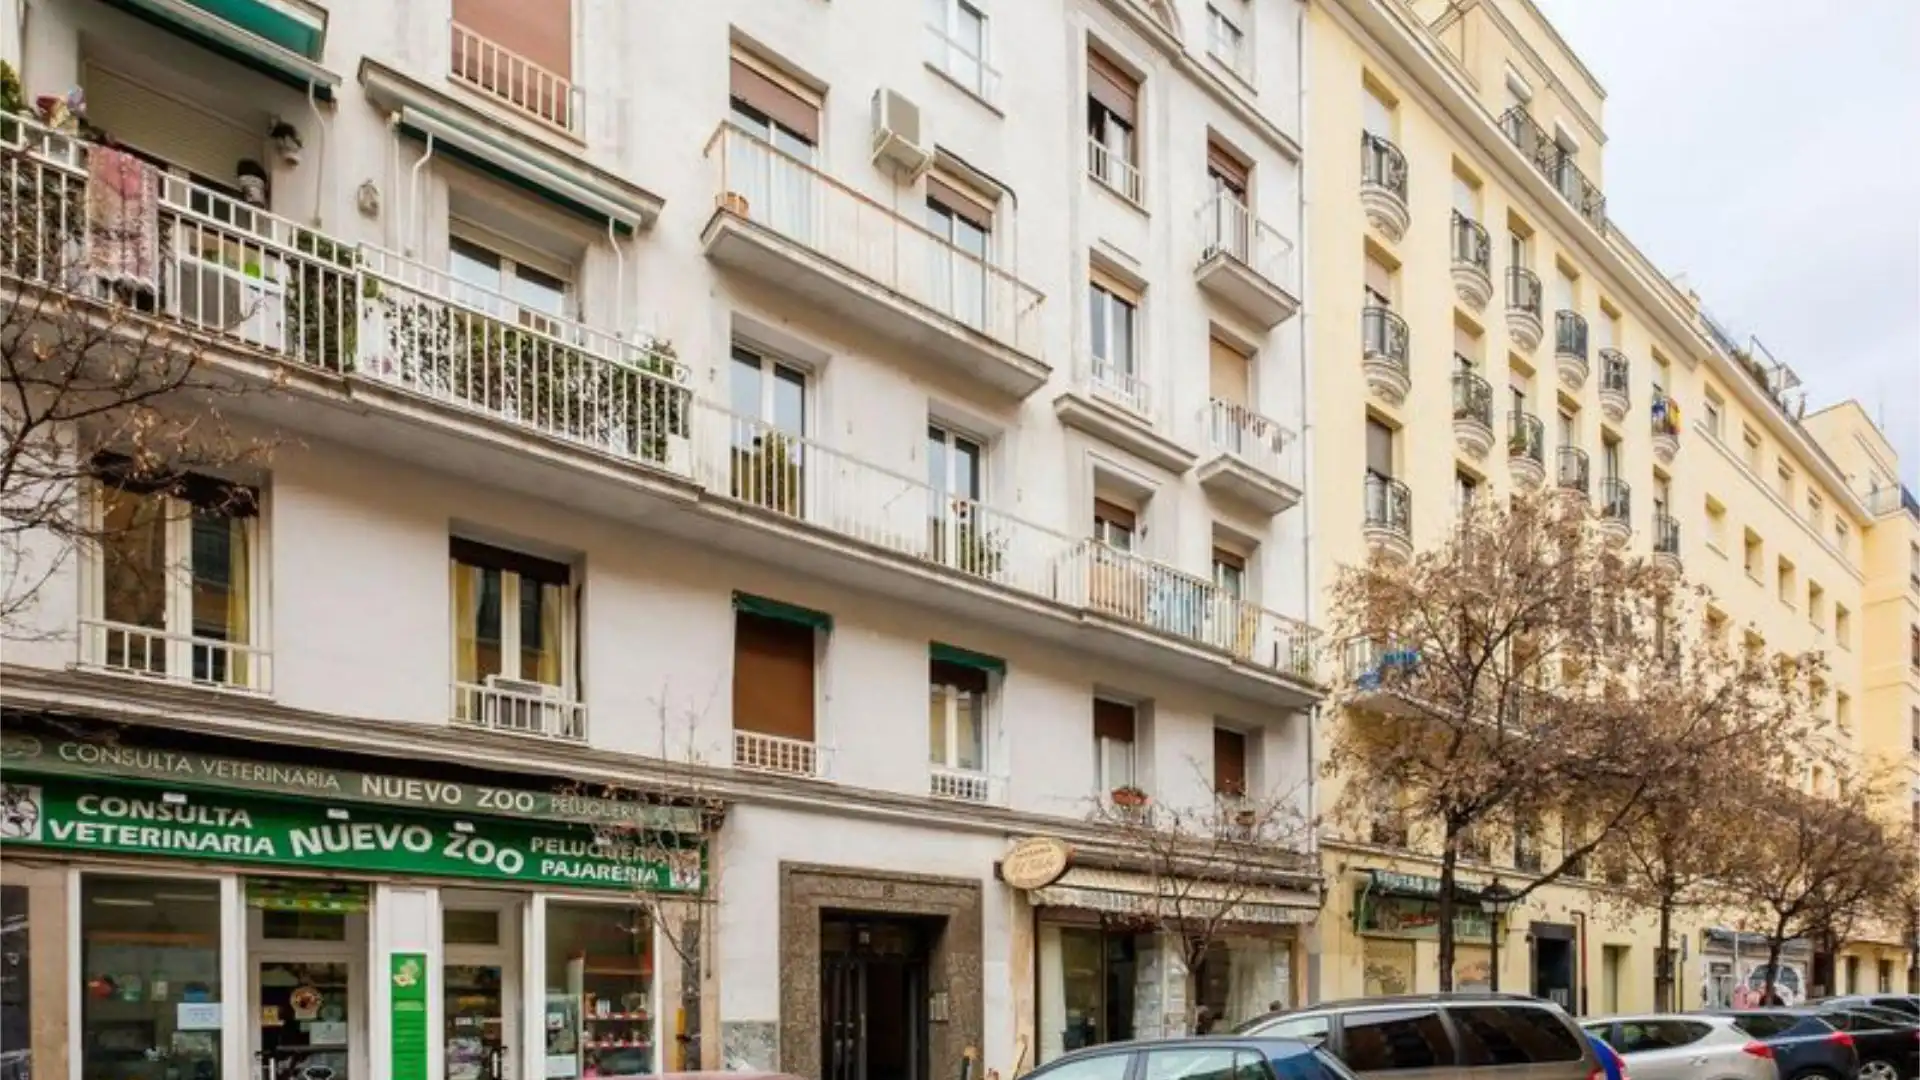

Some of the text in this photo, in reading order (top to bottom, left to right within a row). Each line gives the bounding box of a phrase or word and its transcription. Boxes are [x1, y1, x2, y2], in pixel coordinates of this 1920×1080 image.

[59, 742, 193, 774] CONSULTA
[201, 759, 341, 790] VETERINARIA
[361, 775, 462, 804] NUEVO
[477, 788, 534, 812] ZOO
[76, 795, 253, 829] CONSULTA
[48, 819, 276, 856] VETERINARIA
[289, 823, 524, 874] NUEVO ZOO
[541, 859, 659, 883] PAJARERIA
